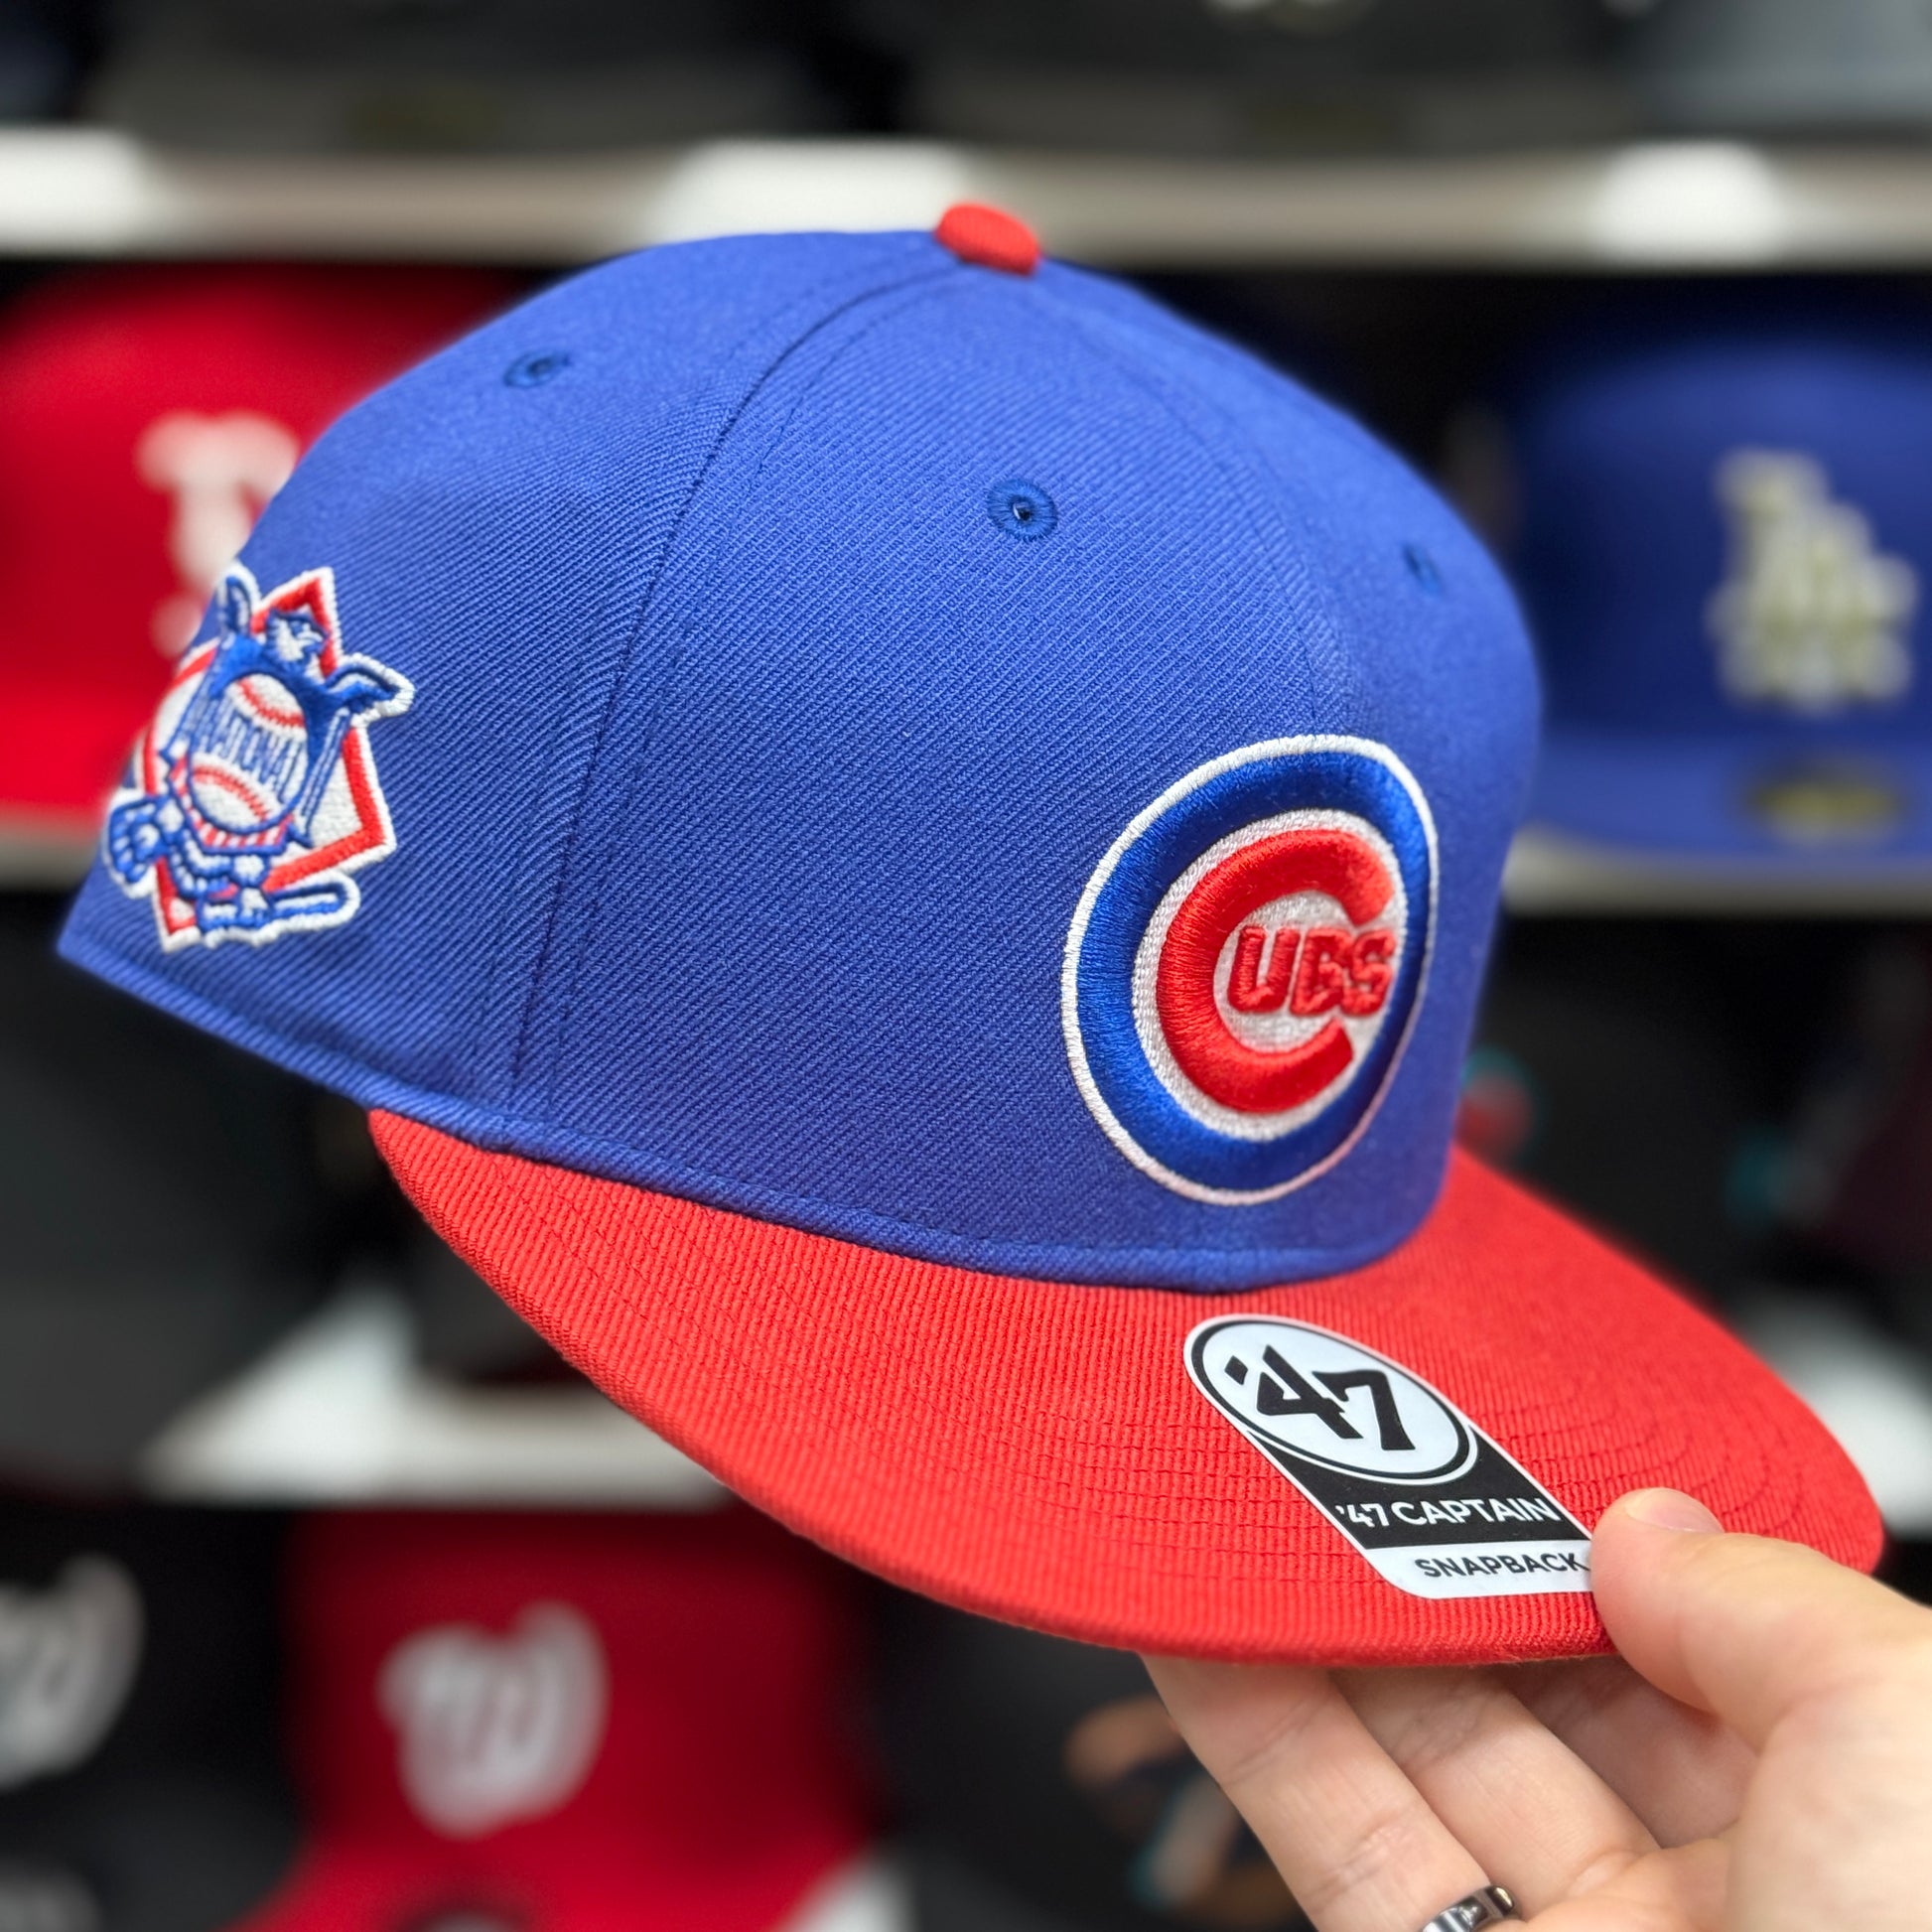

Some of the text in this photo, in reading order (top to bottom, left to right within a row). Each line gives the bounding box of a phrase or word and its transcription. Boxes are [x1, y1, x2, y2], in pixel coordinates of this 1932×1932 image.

[1157, 828, 1397, 1114] CUBS
[1224, 1344, 1416, 1451] '47
[1335, 1497, 1562, 1528] '47 CAPTAIN
[1414, 1552, 1591, 1578] SNAPBACK
